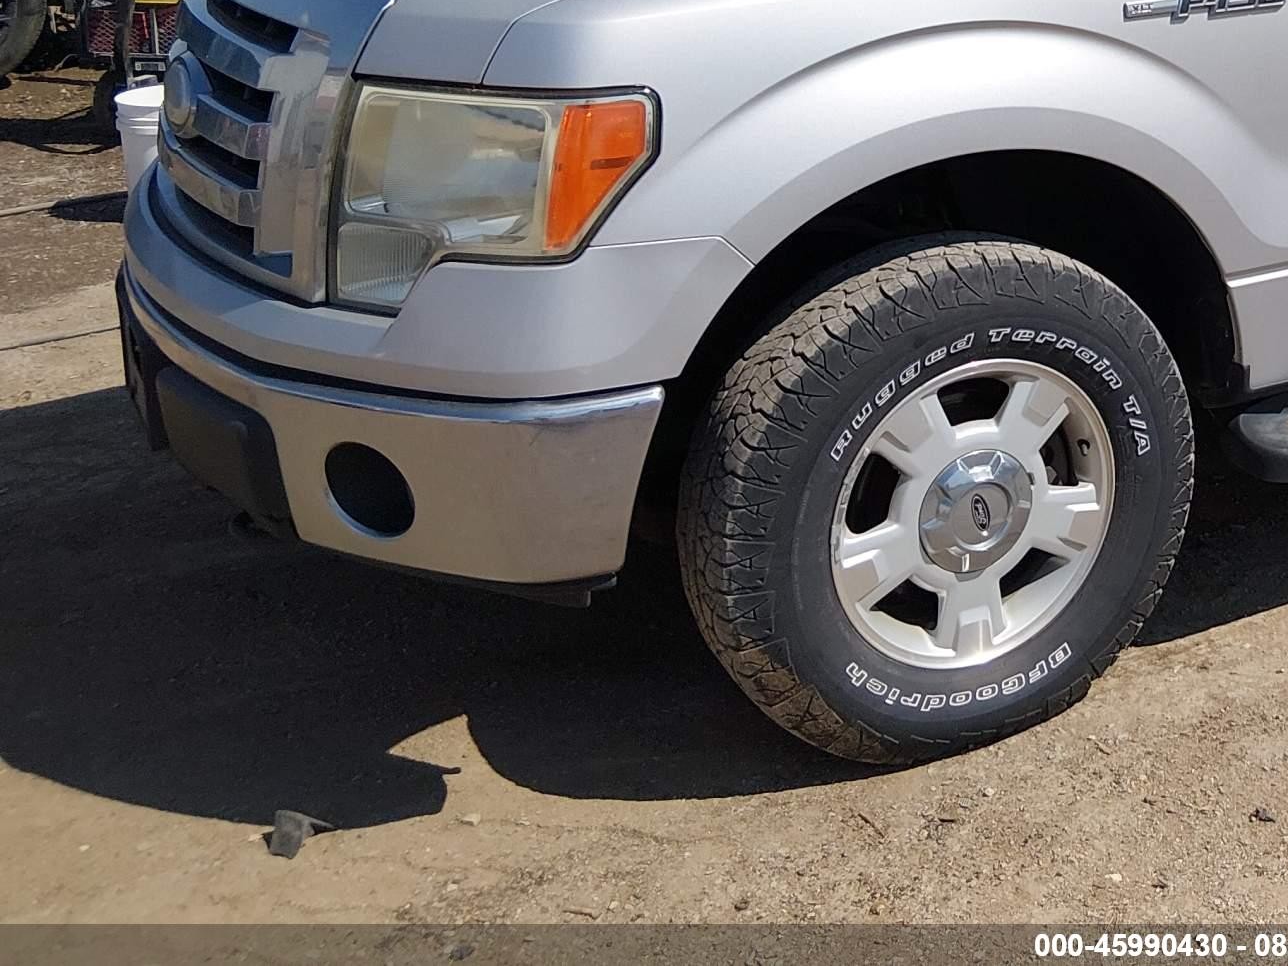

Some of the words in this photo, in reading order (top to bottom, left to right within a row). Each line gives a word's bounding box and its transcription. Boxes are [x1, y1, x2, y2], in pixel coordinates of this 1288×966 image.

[830, 332, 975, 462] Rugged
[989, 327, 1122, 390] Terrain
[845, 642, 1072, 712] BFGoodrich
